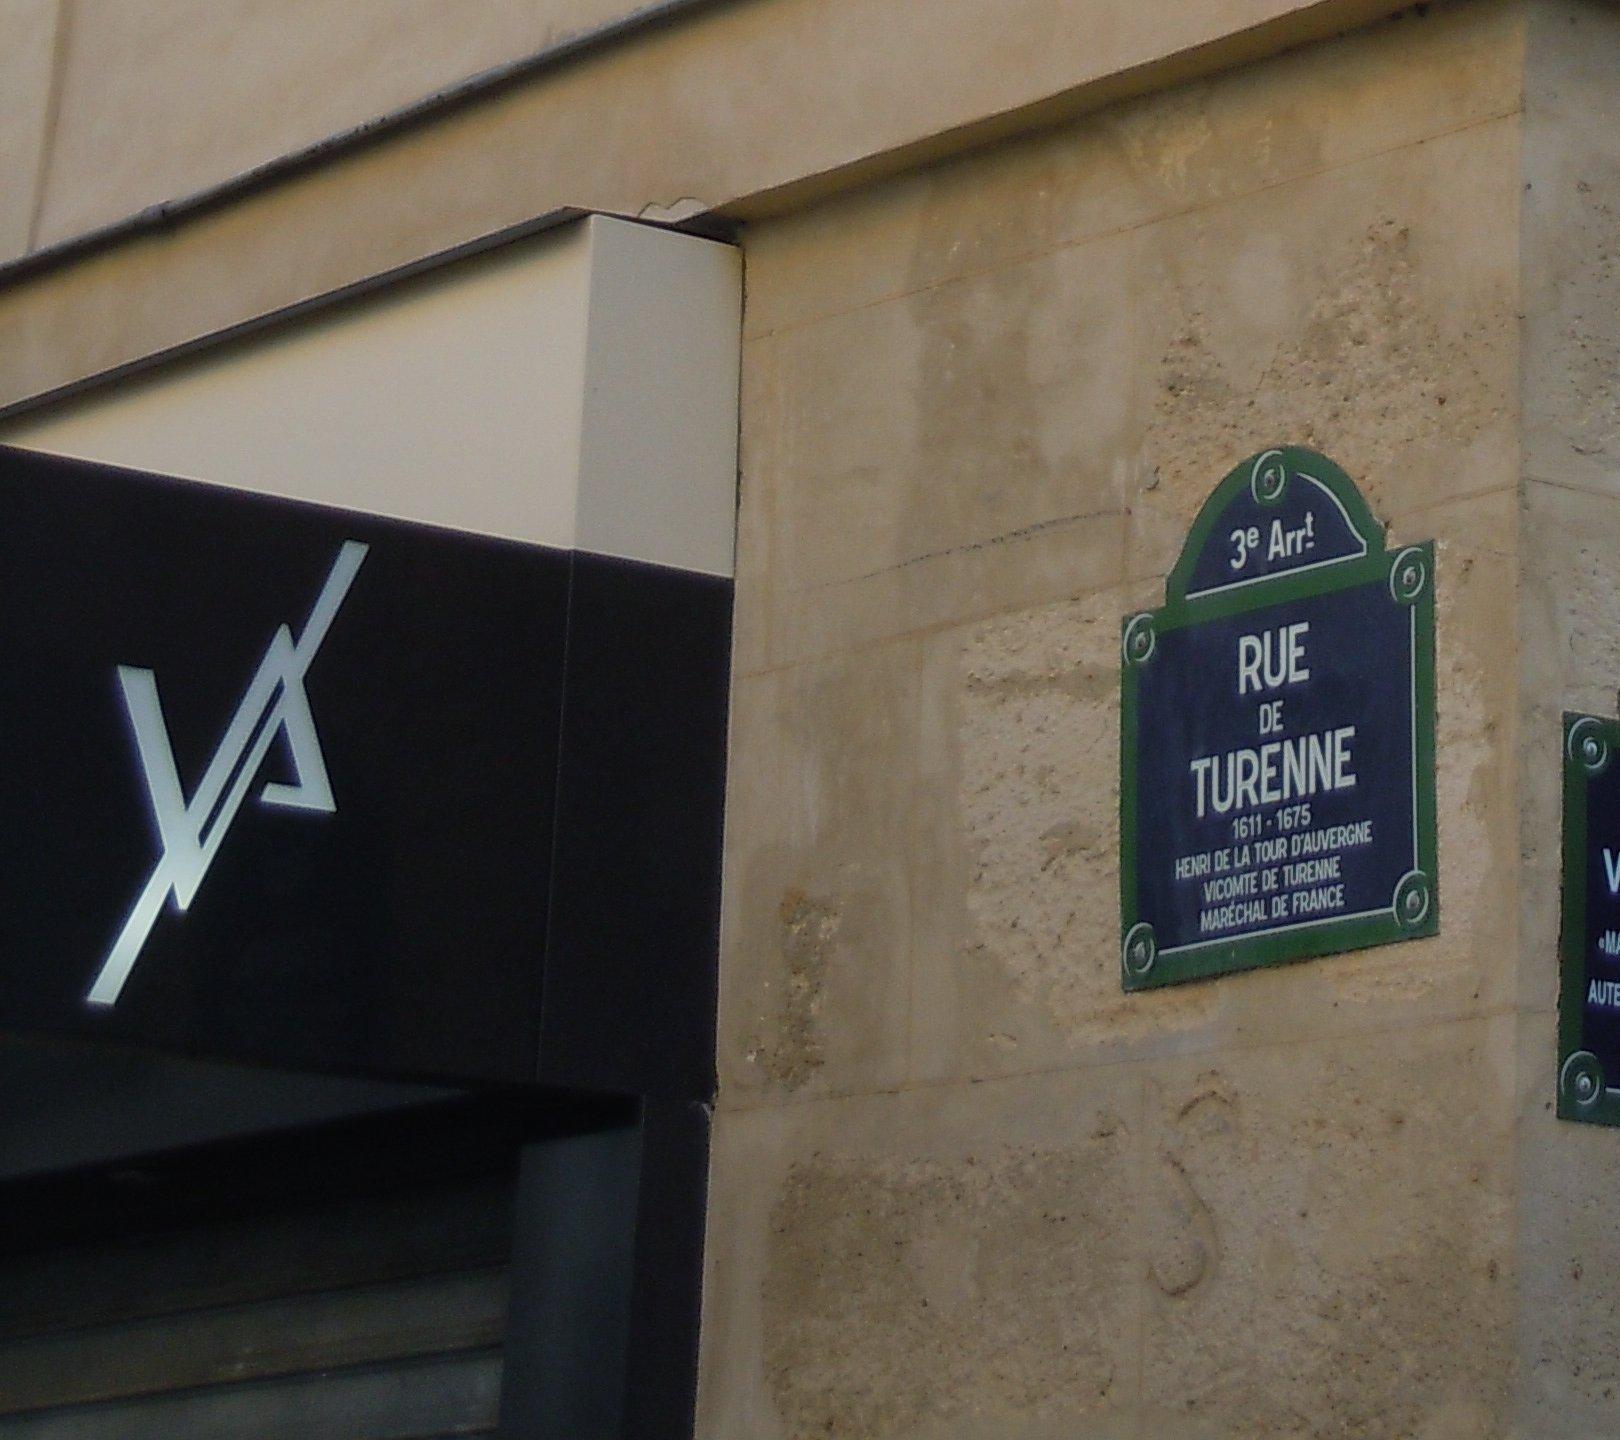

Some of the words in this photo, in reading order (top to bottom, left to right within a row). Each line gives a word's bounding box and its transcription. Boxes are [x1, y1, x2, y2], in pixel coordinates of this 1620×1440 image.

[1231, 526, 1260, 569] 3e
[1238, 622, 1310, 694] RUE
[1259, 700, 1284, 733] DE
[1190, 727, 1356, 818] TURENNE
[1233, 814, 1262, 839] 1611
[1277, 804, 1311, 831] 1675
[1175, 853, 1210, 880] HENRI
[1214, 848, 1231, 872] DE
[1234, 846, 1250, 868] LA
[1254, 838, 1287, 864] TOUR
[1292, 820, 1373, 856] D'AUVERGNE
[1204, 872, 1258, 903] VICOMTE
[1262, 868, 1279, 892] DE
[1282, 855, 1341, 887] TURENNE
[1201, 897, 1268, 932] MARÉCHAL
[1272, 895, 1289, 918] DE
[1293, 884, 1346, 914] FRANCE
